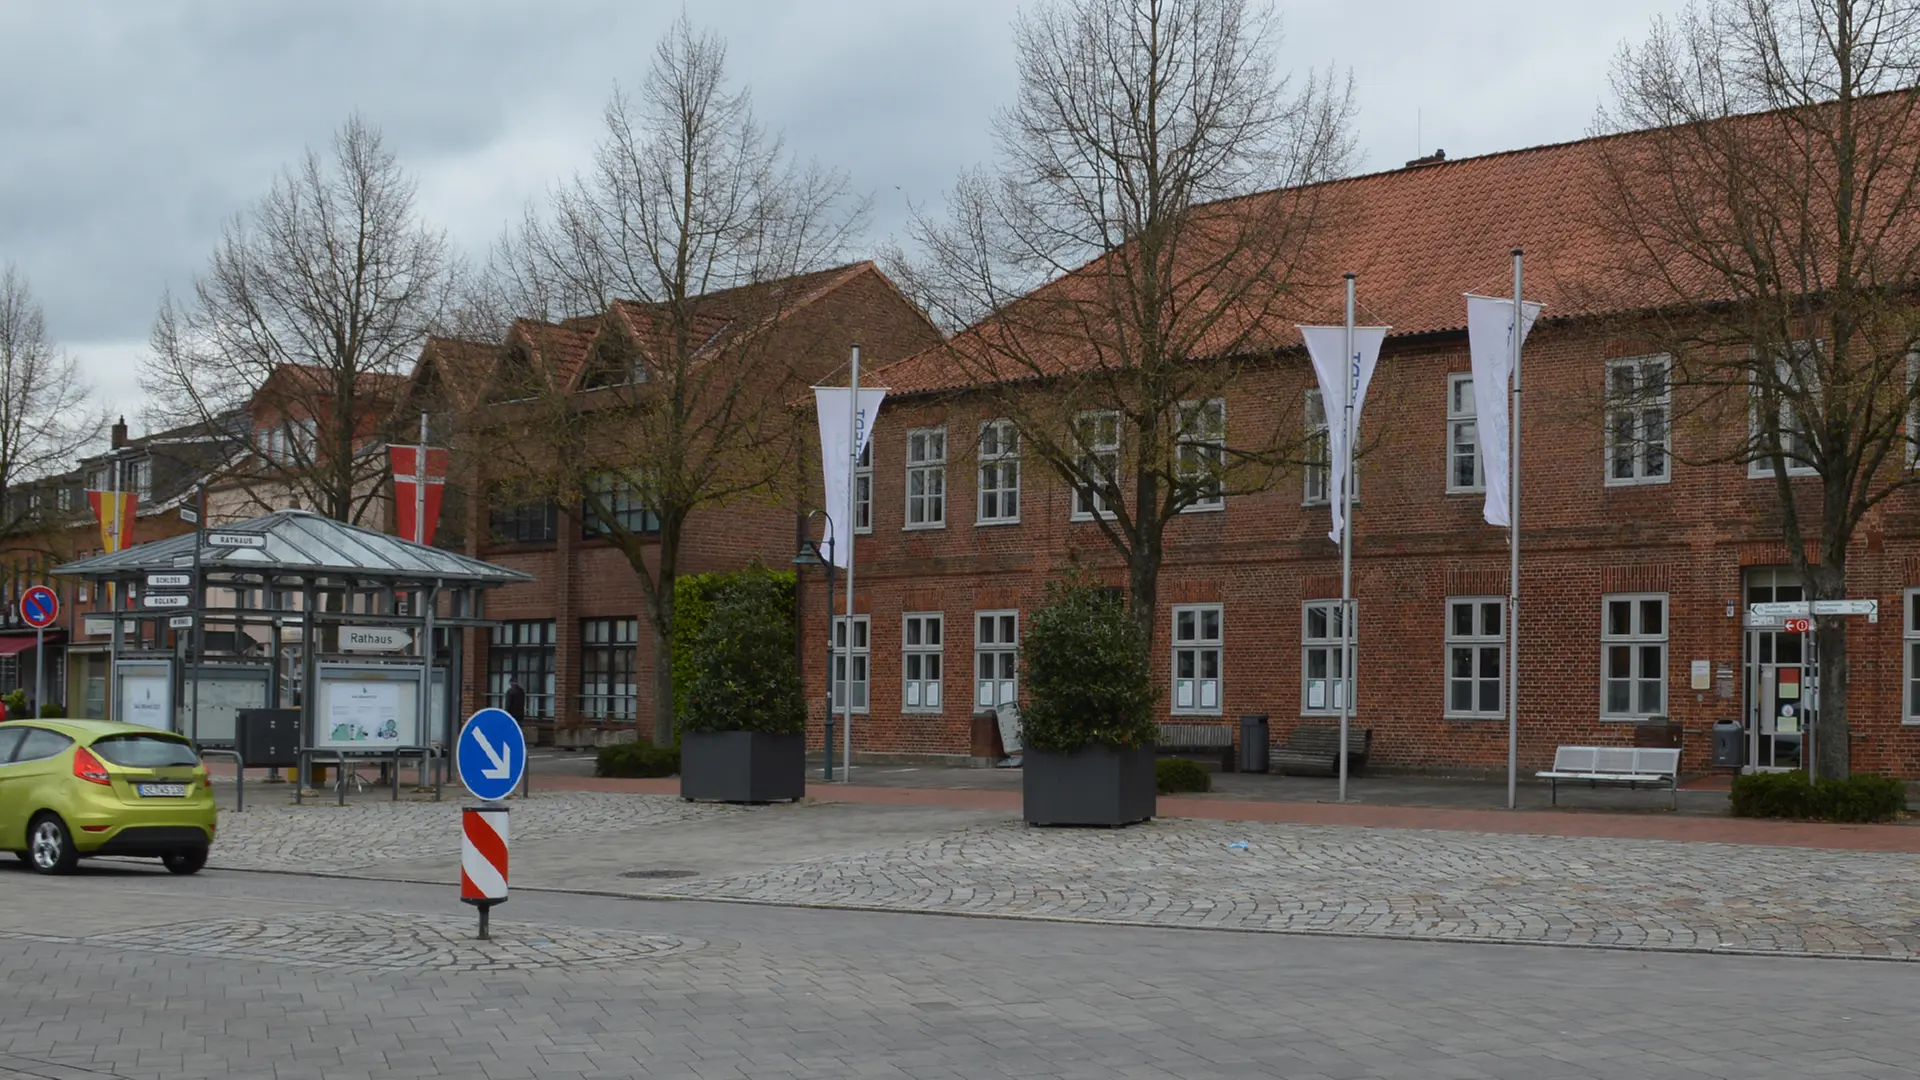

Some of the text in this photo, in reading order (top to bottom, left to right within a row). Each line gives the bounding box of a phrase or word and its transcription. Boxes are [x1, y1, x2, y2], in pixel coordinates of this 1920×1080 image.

[220, 536, 253, 544] RATHAUS
[155, 576, 181, 584] SCHLOSS
[154, 597, 178, 605] ROLAND
[350, 633, 393, 644] Rathaus
